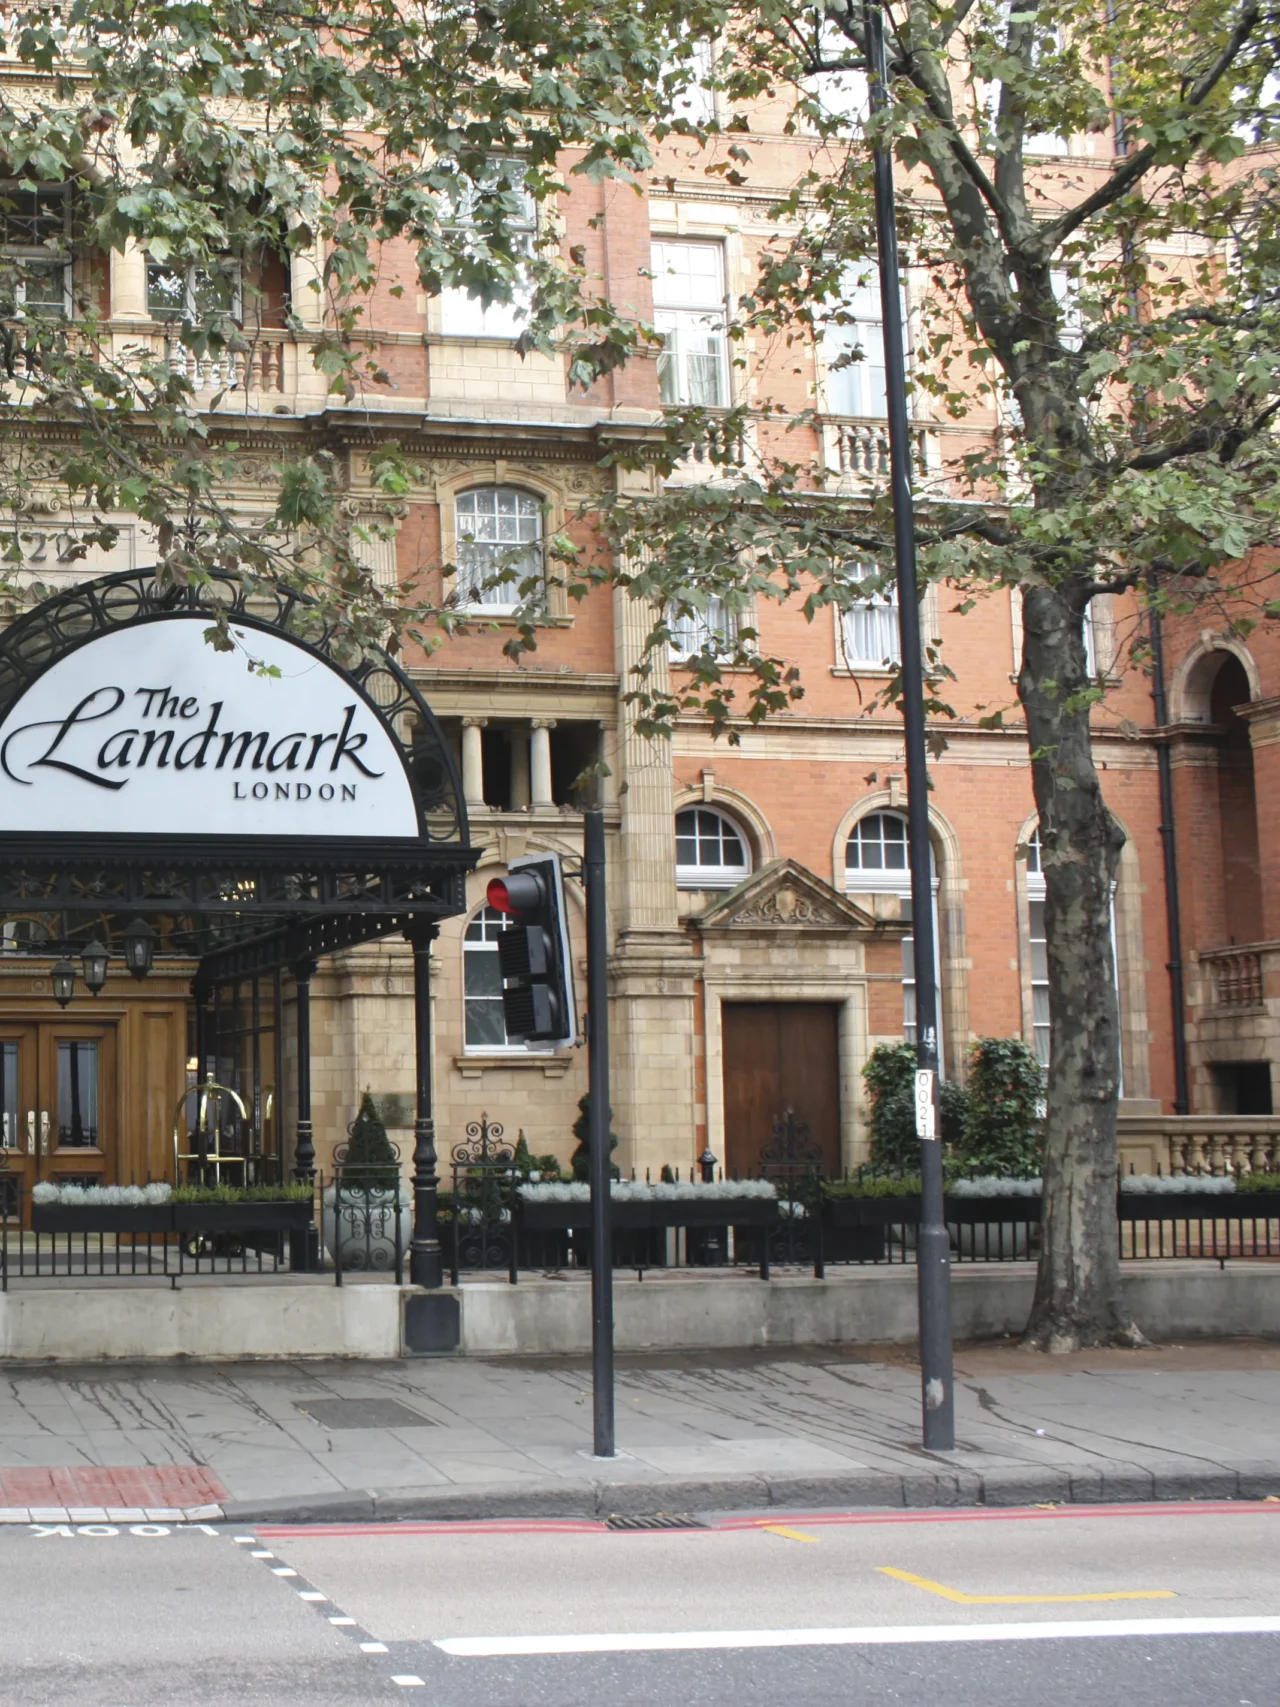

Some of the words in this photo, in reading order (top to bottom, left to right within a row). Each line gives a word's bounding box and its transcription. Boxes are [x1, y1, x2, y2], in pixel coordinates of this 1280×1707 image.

[134, 685, 200, 718] The
[0, 686, 385, 790] Landmark
[233, 781, 358, 802] LONDON
[918, 1072, 929, 1137] 0021
[28, 1523, 220, 1537] LOOK
